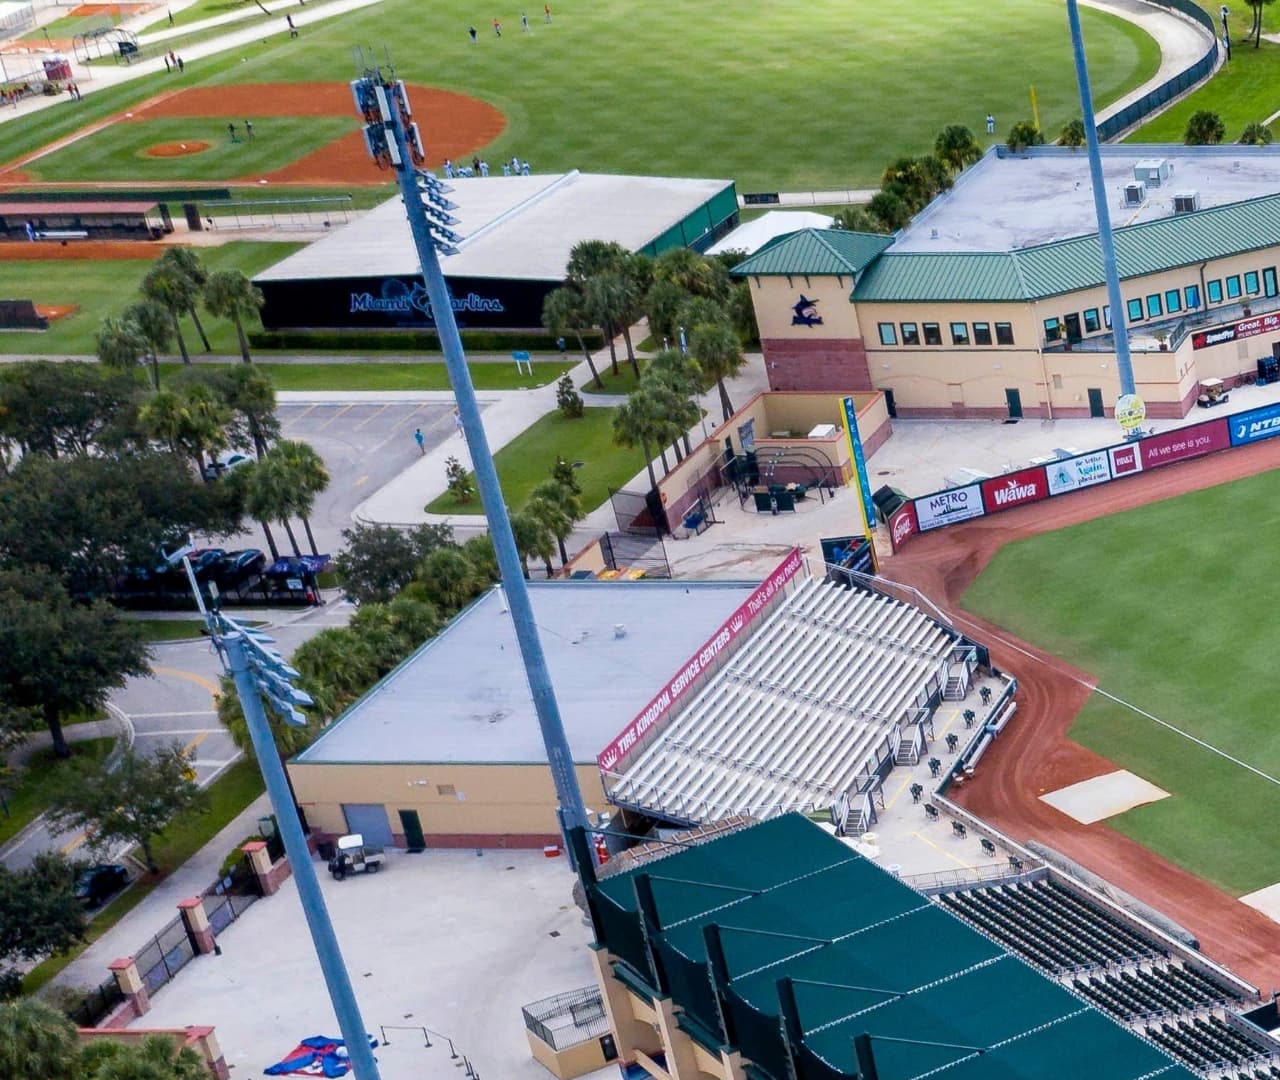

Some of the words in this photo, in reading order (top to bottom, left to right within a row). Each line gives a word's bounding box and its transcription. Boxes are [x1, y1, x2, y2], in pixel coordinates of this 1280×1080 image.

[350, 292, 410, 312] Miami
[1238, 321, 1261, 331] Great.
[1264, 316, 1278, 327] Big.
[1148, 449, 1158, 459] All
[1160, 446, 1171, 455] we
[1172, 442, 1186, 452] see
[1187, 440, 1194, 448] is
[1195, 436, 1212, 448] you.
[847, 409, 872, 514] SEACOAST
[930, 491, 968, 511] METRO
[994, 482, 1037, 505] Wawa
[747, 591, 766, 615] That's
[766, 583, 774, 599] all
[773, 575, 784, 592] you
[671, 659, 700, 699] SERVICE
[700, 627, 730, 667] CENTERS
[618, 727, 637, 754] TIRE
[636, 694, 671, 736] KINGDOM
